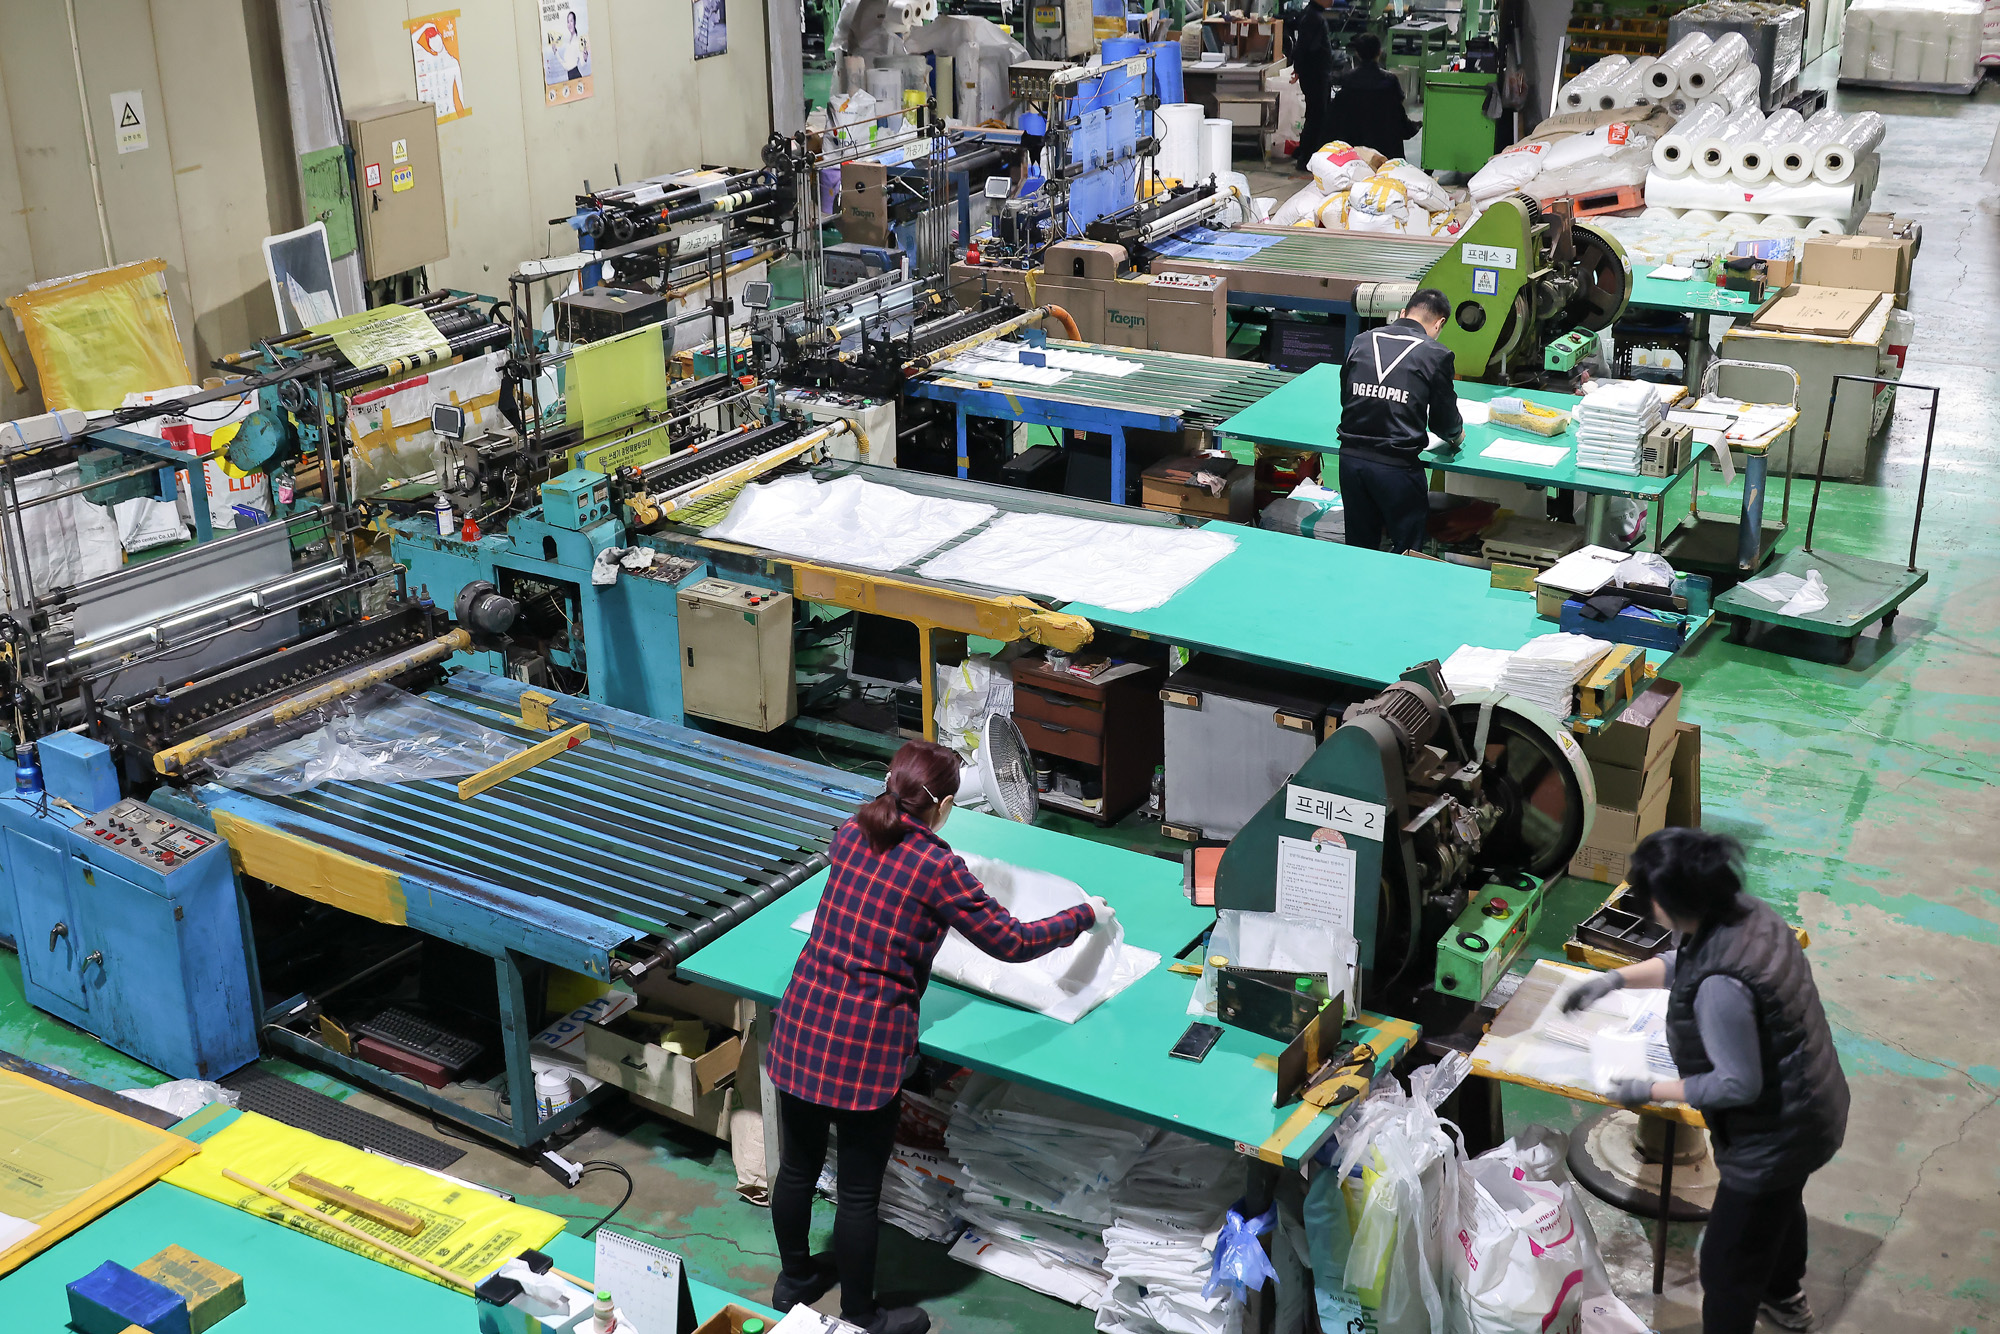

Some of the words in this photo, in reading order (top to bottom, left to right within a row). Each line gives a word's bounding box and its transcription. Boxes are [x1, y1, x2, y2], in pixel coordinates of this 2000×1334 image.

[1142, 62, 1146, 71] 5
[906, 144, 924, 157] 가공기
[685, 234, 710, 250] 가공기
[713, 233, 718, 243] 3
[1467, 249, 1500, 262] 프레스
[1505, 253, 1512, 264] 3
[1107, 309, 1145, 329] Taejin
[1352, 382, 1410, 404] DGEEOPAE
[1295, 795, 1353, 823] 프레스
[1364, 812, 1375, 829] 2
[537, 998, 610, 1045] HDPE
[1535, 1209, 1557, 1224] Linear
